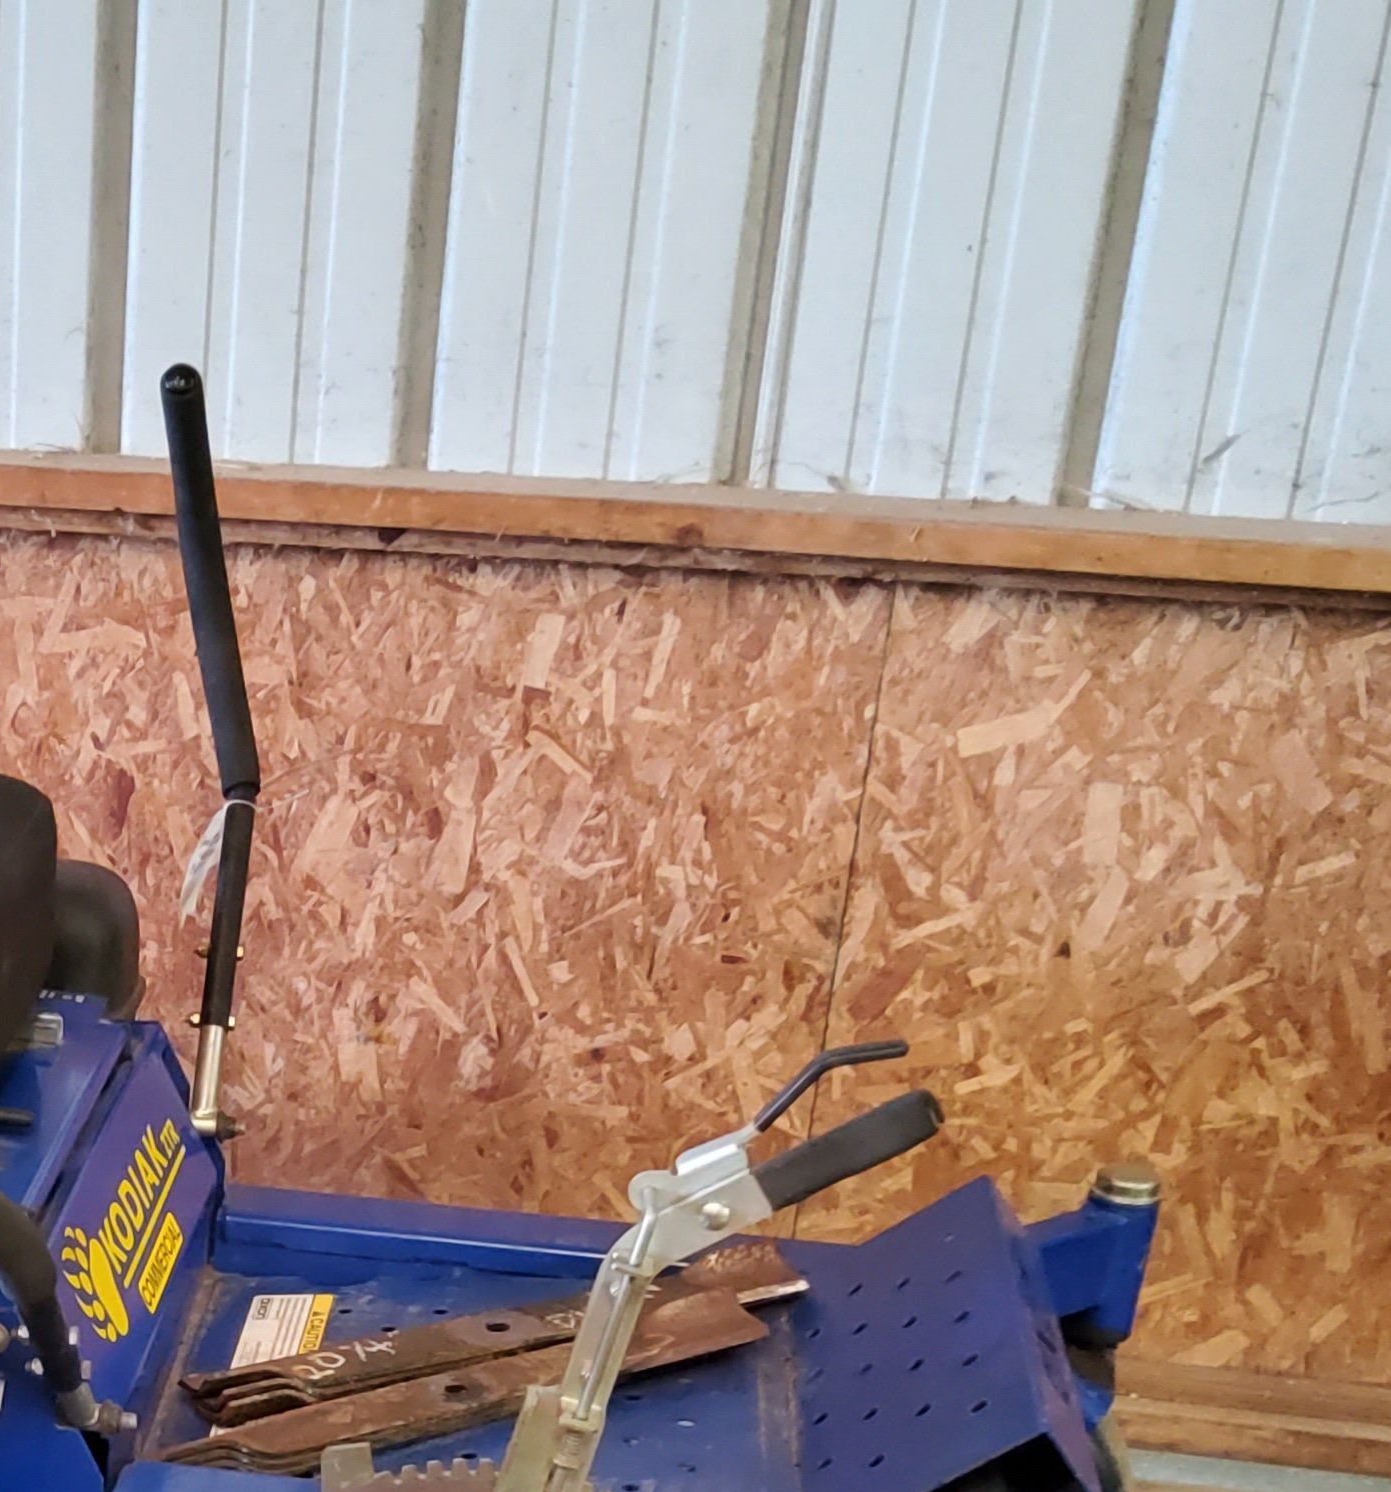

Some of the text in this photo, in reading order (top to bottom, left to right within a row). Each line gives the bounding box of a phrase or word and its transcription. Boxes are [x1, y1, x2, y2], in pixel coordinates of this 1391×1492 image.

[98, 1123, 169, 1275] KODIAK
[141, 1223, 181, 1308] COMMERCIAL
[302, 1317, 325, 1351] CAUTIO
